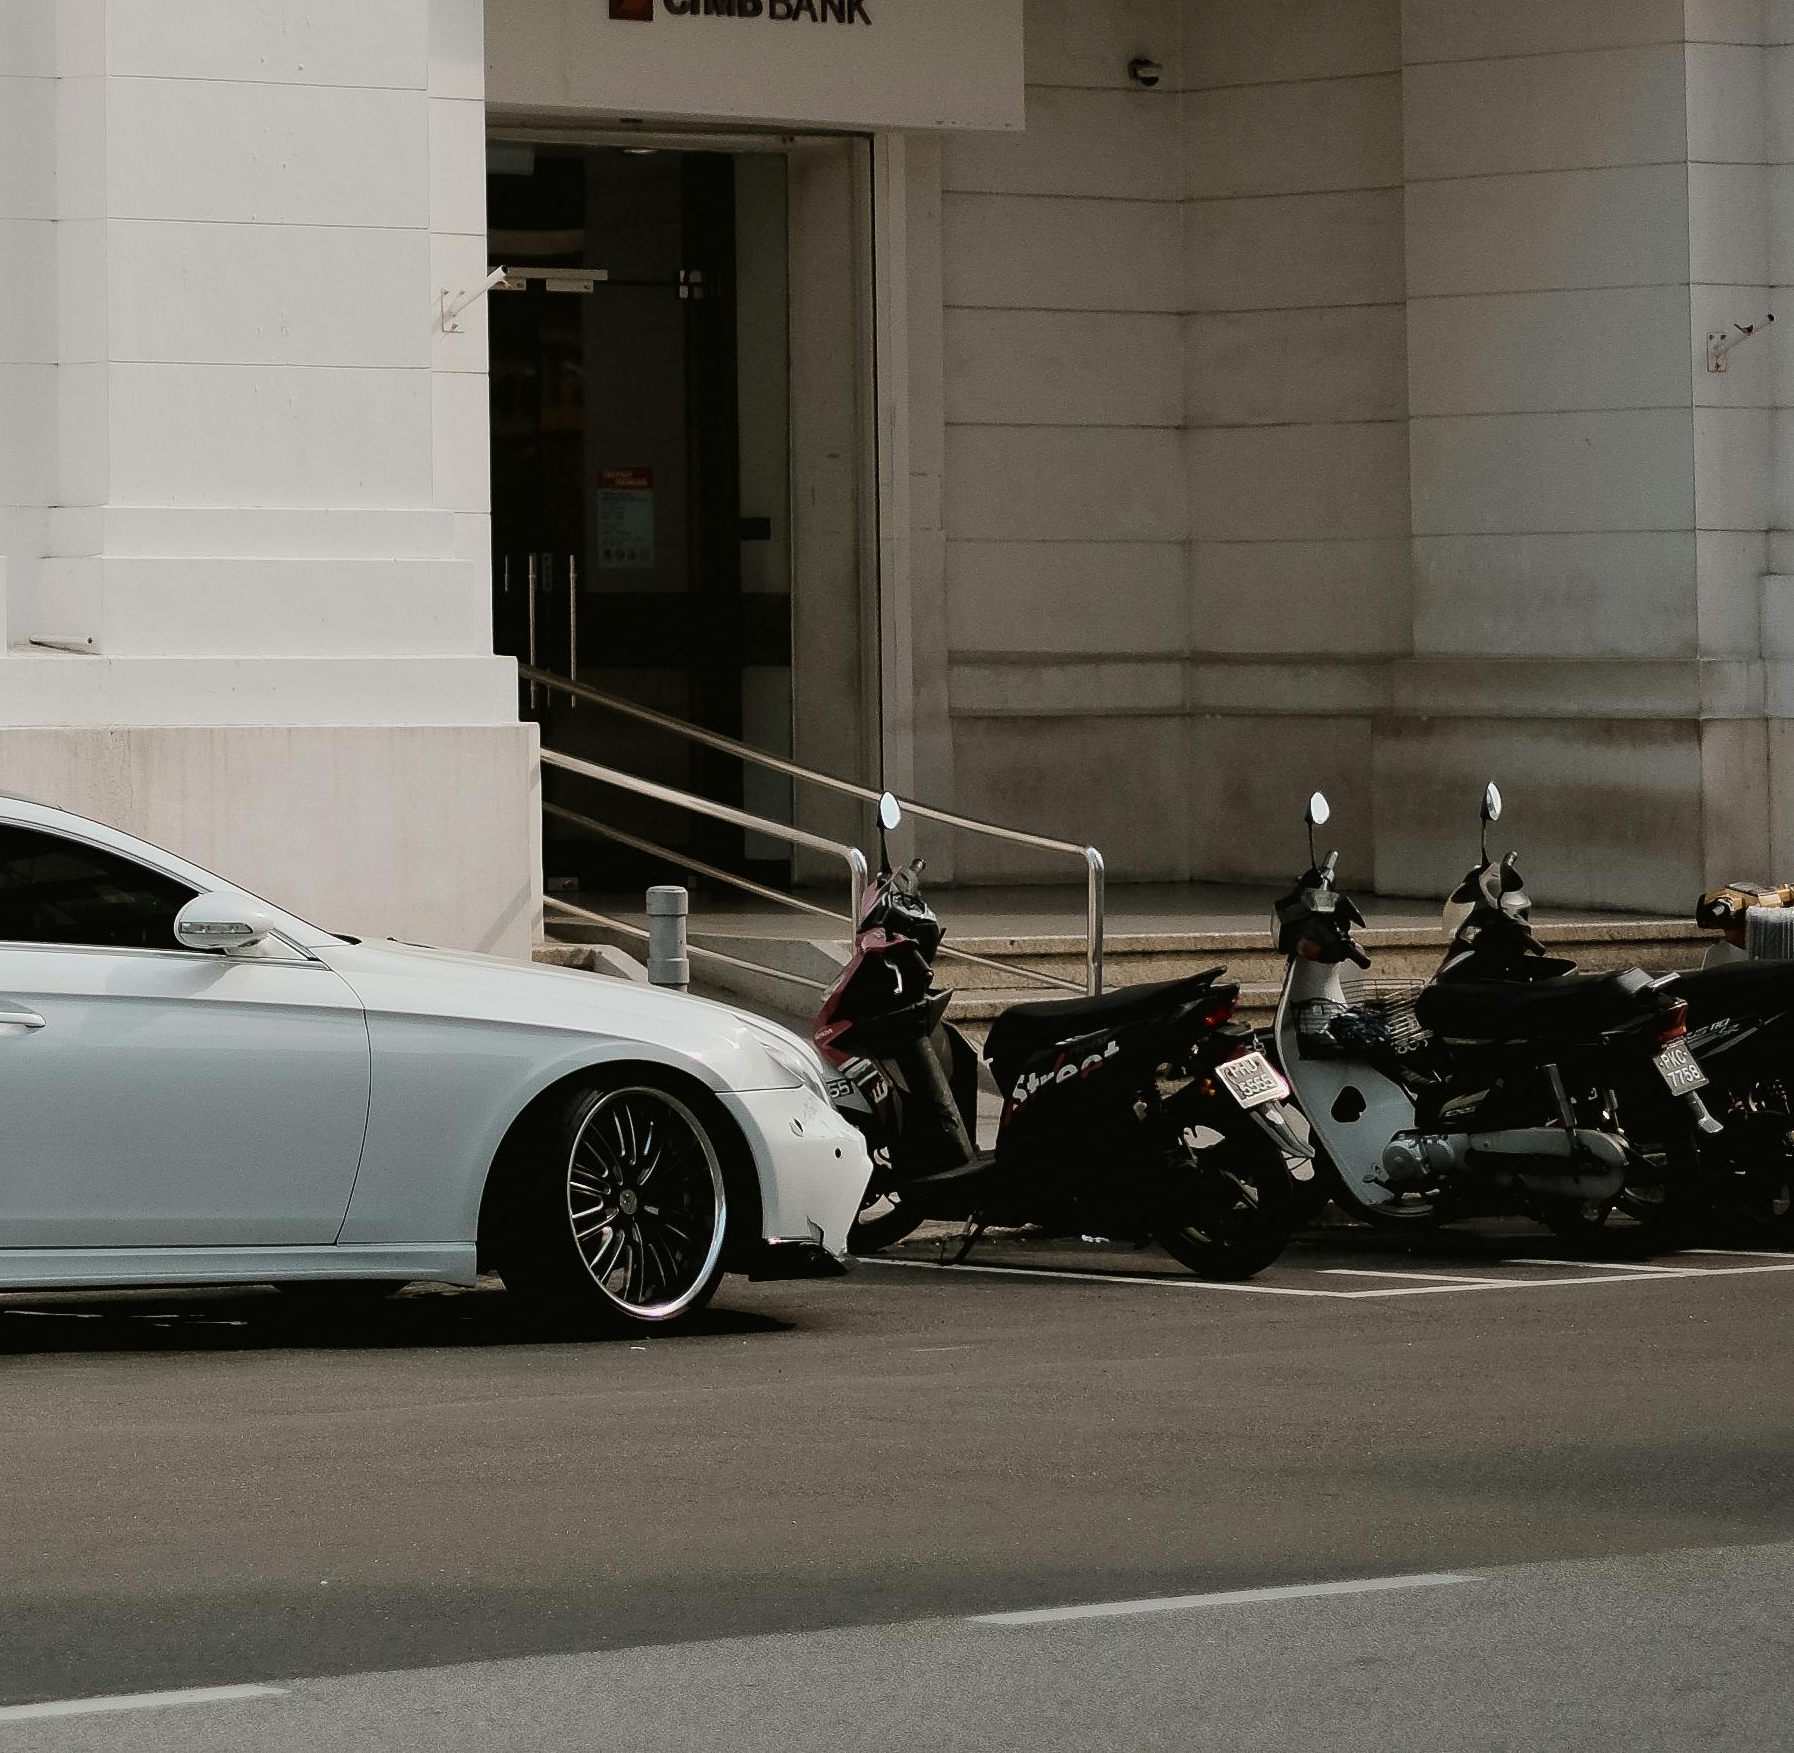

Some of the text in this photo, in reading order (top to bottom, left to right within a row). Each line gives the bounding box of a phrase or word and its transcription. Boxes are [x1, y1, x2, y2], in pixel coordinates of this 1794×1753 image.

[1660, 1048, 1686, 1070] PKC
[1238, 1073, 1274, 1096] 5555
[1667, 1064, 1701, 1087] 7758
